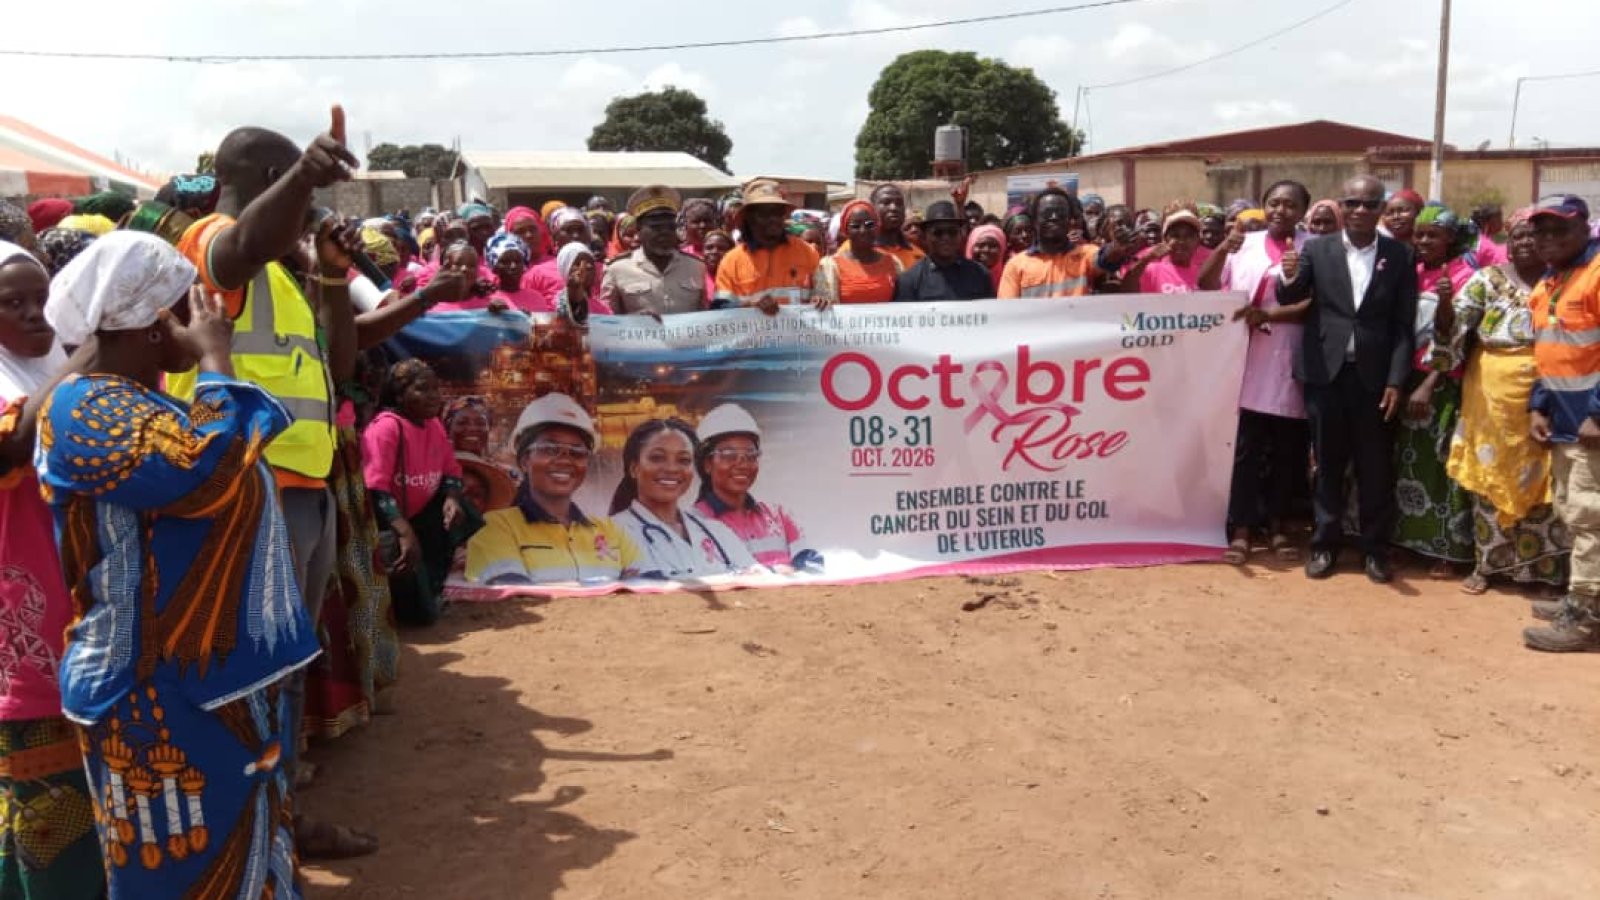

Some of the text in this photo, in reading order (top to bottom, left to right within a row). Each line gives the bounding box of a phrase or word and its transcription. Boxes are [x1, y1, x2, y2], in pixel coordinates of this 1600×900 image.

[687, 326, 700, 338] DE
[831, 315, 844, 329] DE
[919, 314, 936, 328] DU
[940, 313, 988, 328] CANCER
[1121, 311, 1225, 333] Montage
[1121, 335, 1175, 349] GOLD
[991, 407, 1130, 472] Rose
[851, 446, 935, 468] OCT. 2026
[896, 479, 1086, 511] ENSEMBLE CONTRE LE
[870, 500, 1110, 535] CANCER DU SEIN ET DU COL
[937, 526, 1046, 554] DE L'UTERUS
